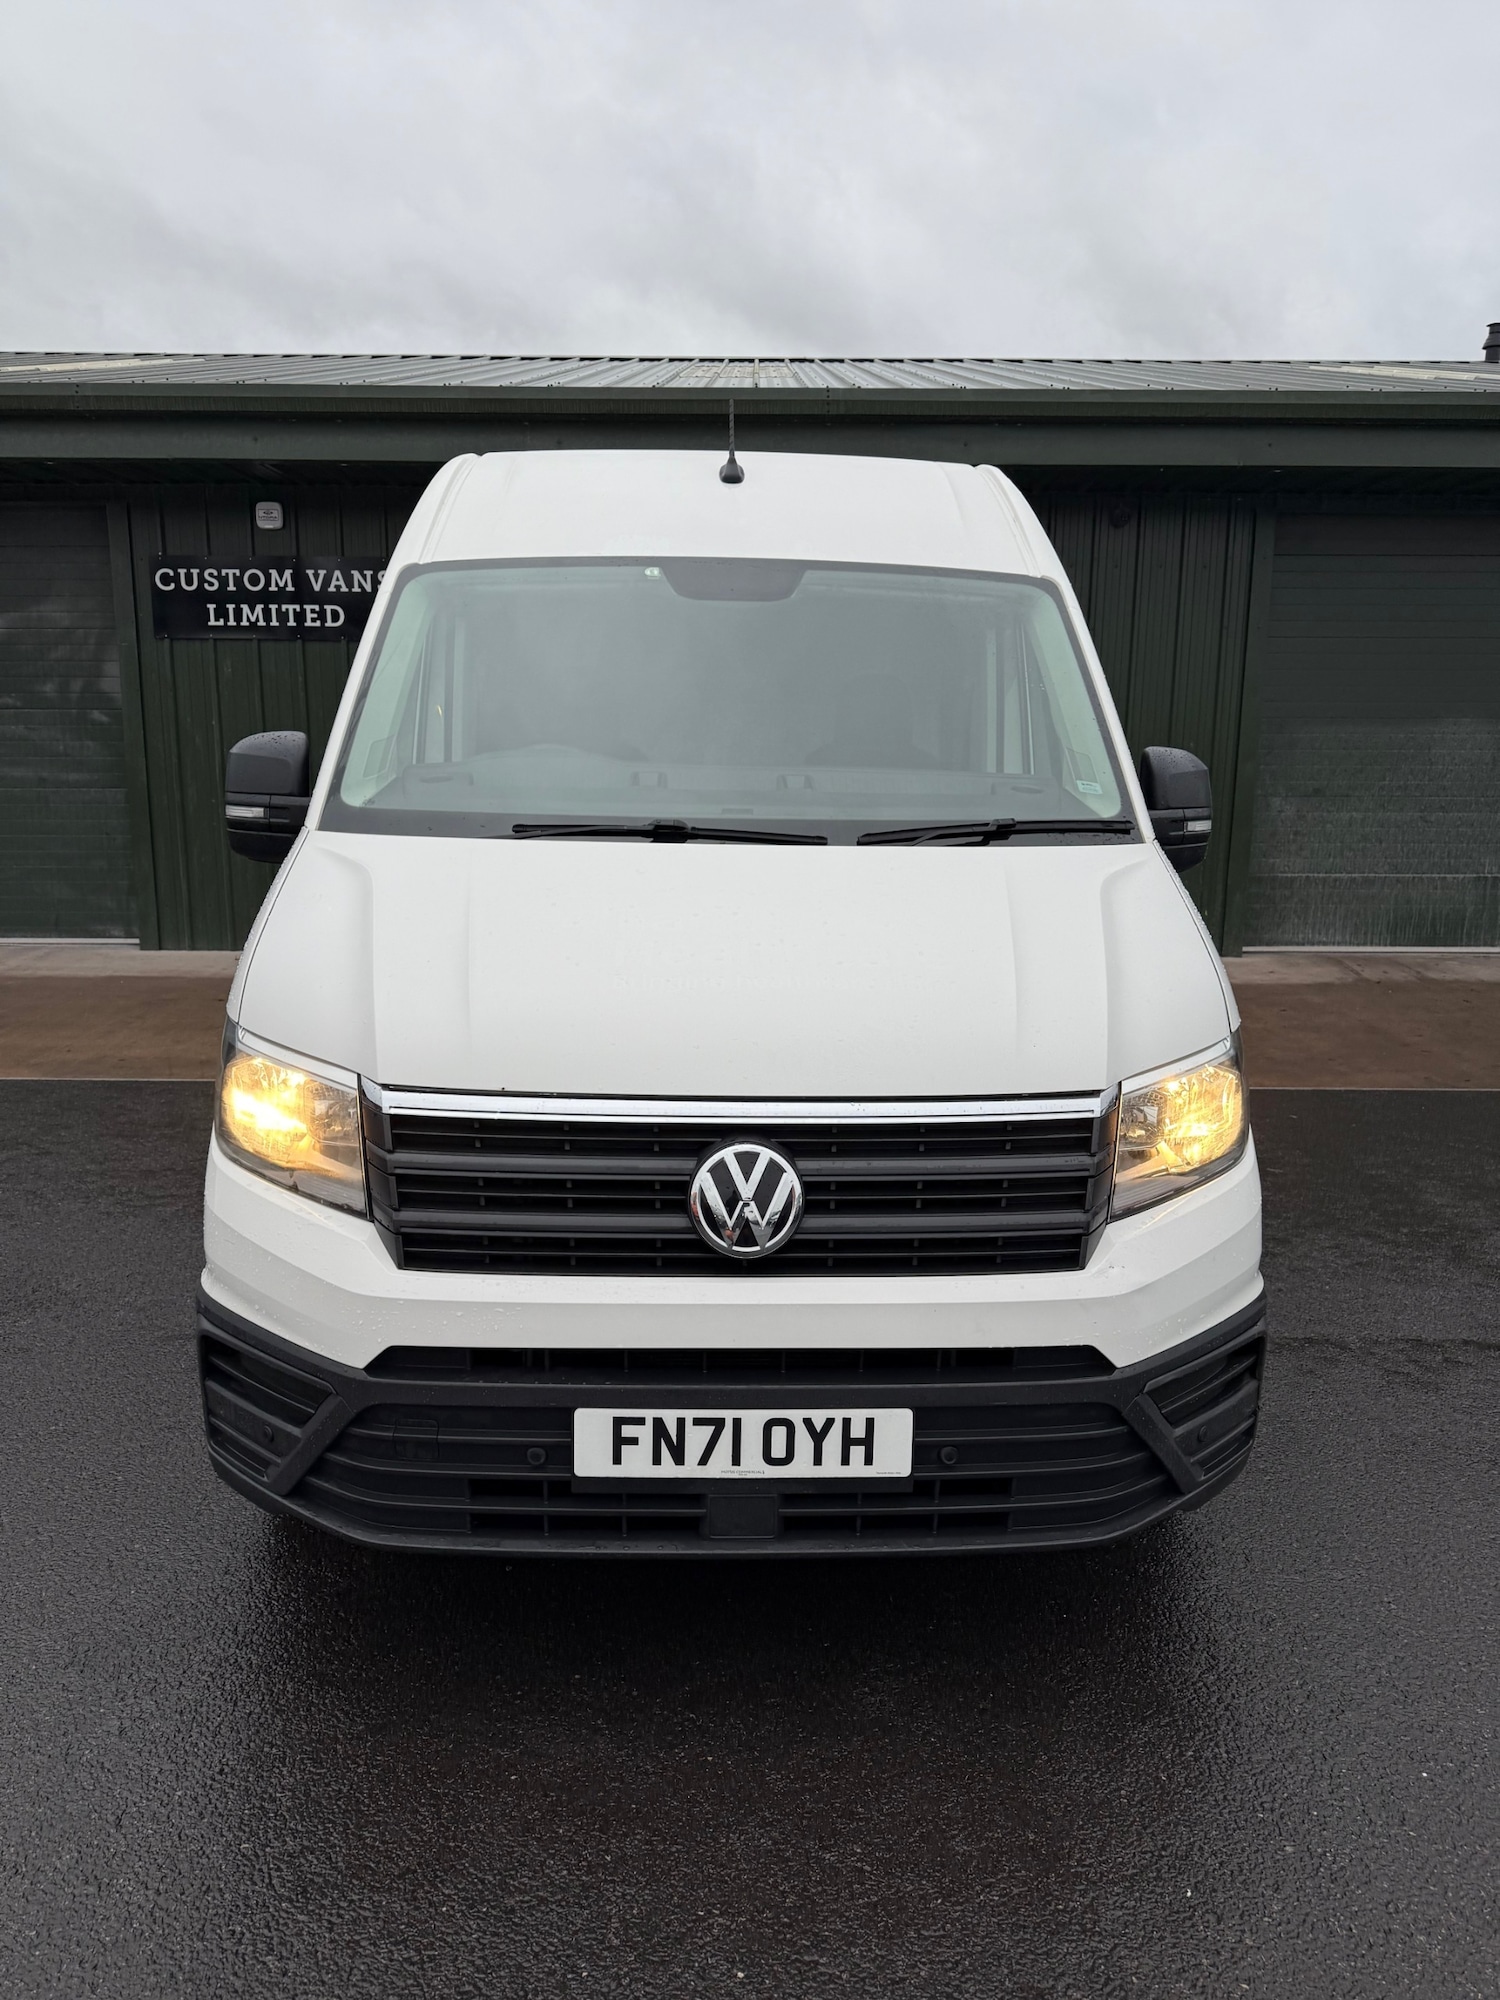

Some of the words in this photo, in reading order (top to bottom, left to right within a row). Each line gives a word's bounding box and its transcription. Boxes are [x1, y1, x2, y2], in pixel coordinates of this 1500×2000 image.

[154, 567, 295, 592] CUSTOM
[206, 603, 345, 627] LIMITED
[690, 1143, 803, 1258] VW
[612, 1416, 742, 1467] FN71
[762, 1417, 875, 1467] OYH
